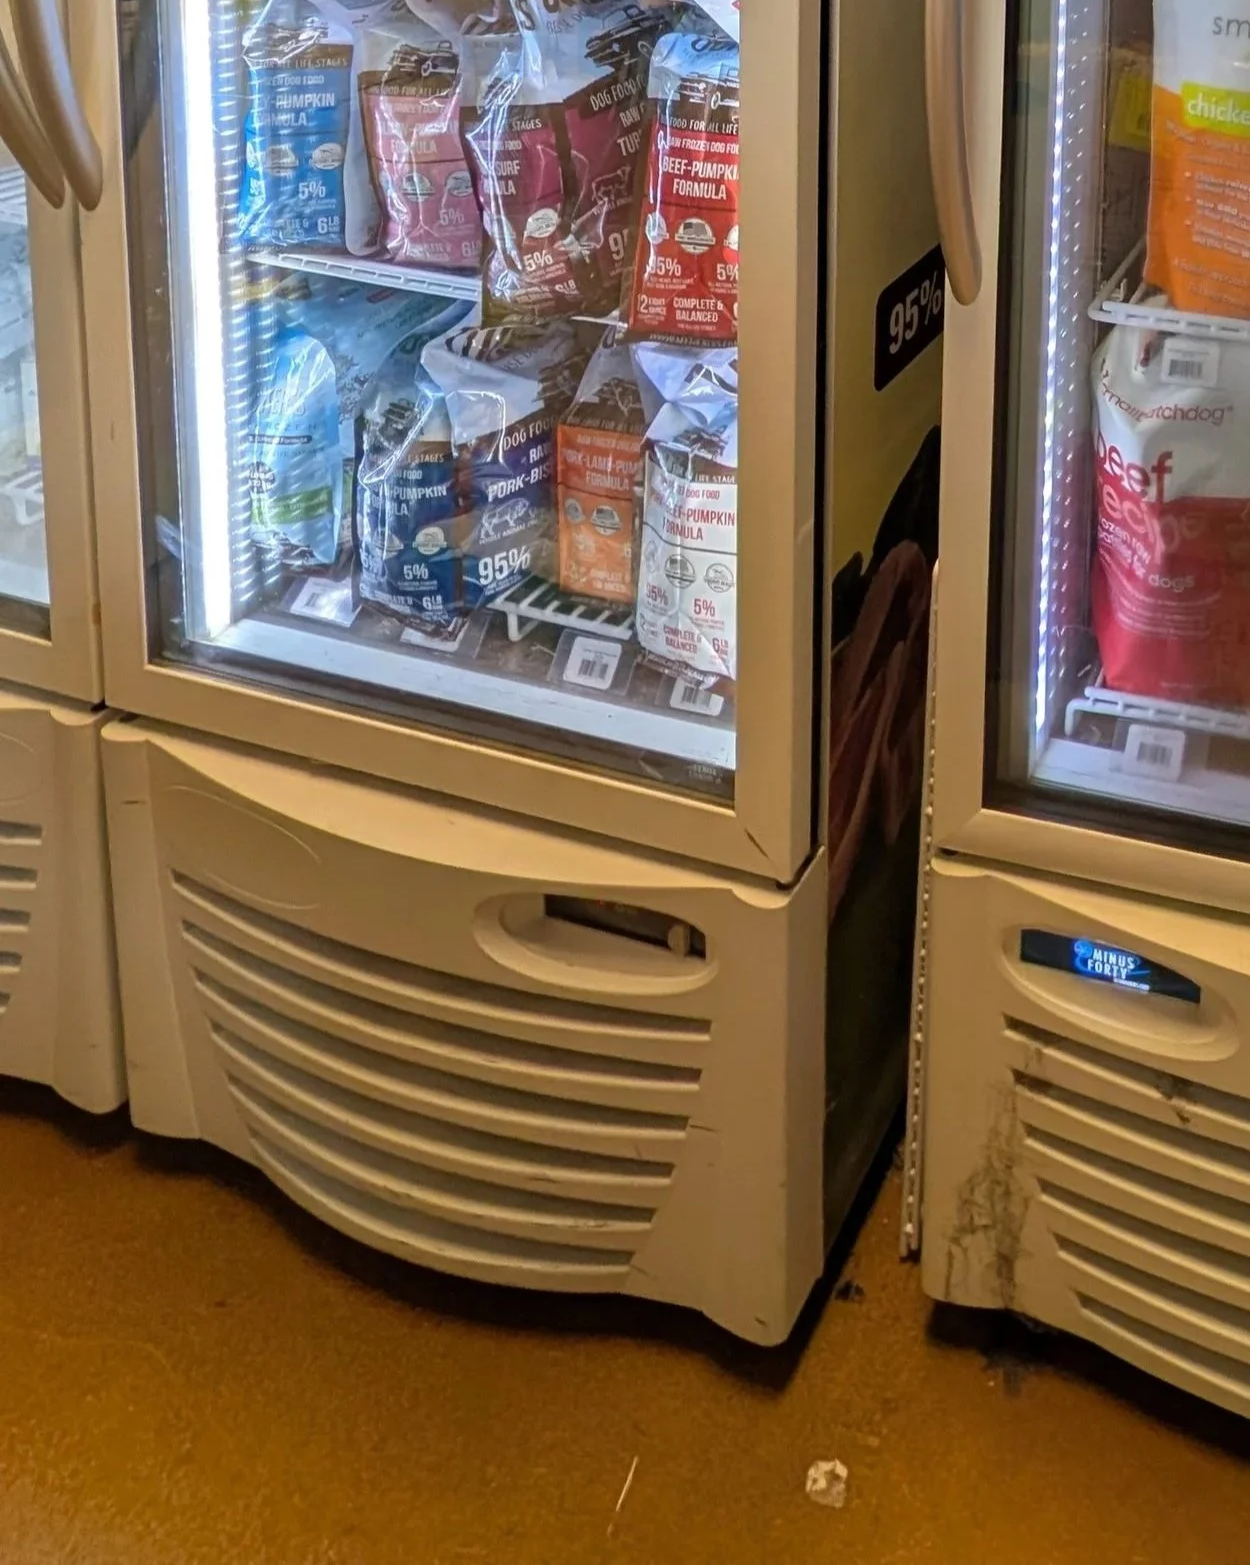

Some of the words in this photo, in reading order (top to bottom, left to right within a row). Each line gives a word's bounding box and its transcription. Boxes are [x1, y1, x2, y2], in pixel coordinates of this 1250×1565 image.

[589, 92, 613, 112] DOG
[511, 118, 543, 132] STAGES
[689, 119, 706, 132] FOR
[707, 121, 720, 133] ALL
[721, 122, 738, 135] LIFE
[710, 141, 726, 153] DOG
[495, 159, 521, 177] SURF
[298, 181, 326, 199] 5%
[672, 181, 727, 202] FORMULA
[316, 216, 329, 235] 6
[439, 209, 466, 226] 5%
[523, 249, 553, 272] 5%
[672, 296, 716, 311] COMPLETE
[716, 299, 725, 311] &
[888, 269, 942, 355] 95%
[675, 308, 719, 323] BALANCED
[502, 431, 527, 452] DOG
[402, 469, 423, 480] FOOD
[694, 472, 711, 483] LIFE
[701, 488, 721, 500] FOOD
[403, 563, 430, 581] 5%
[477, 546, 531, 586] 95%
[1147, 572, 1196, 593] dogs
[422, 594, 432, 611] 6
[693, 597, 716, 617] 5%
[711, 636, 720, 653] 6
[1092, 948, 1136, 970] MINUS
[1087, 958, 1129, 980] FORTY
